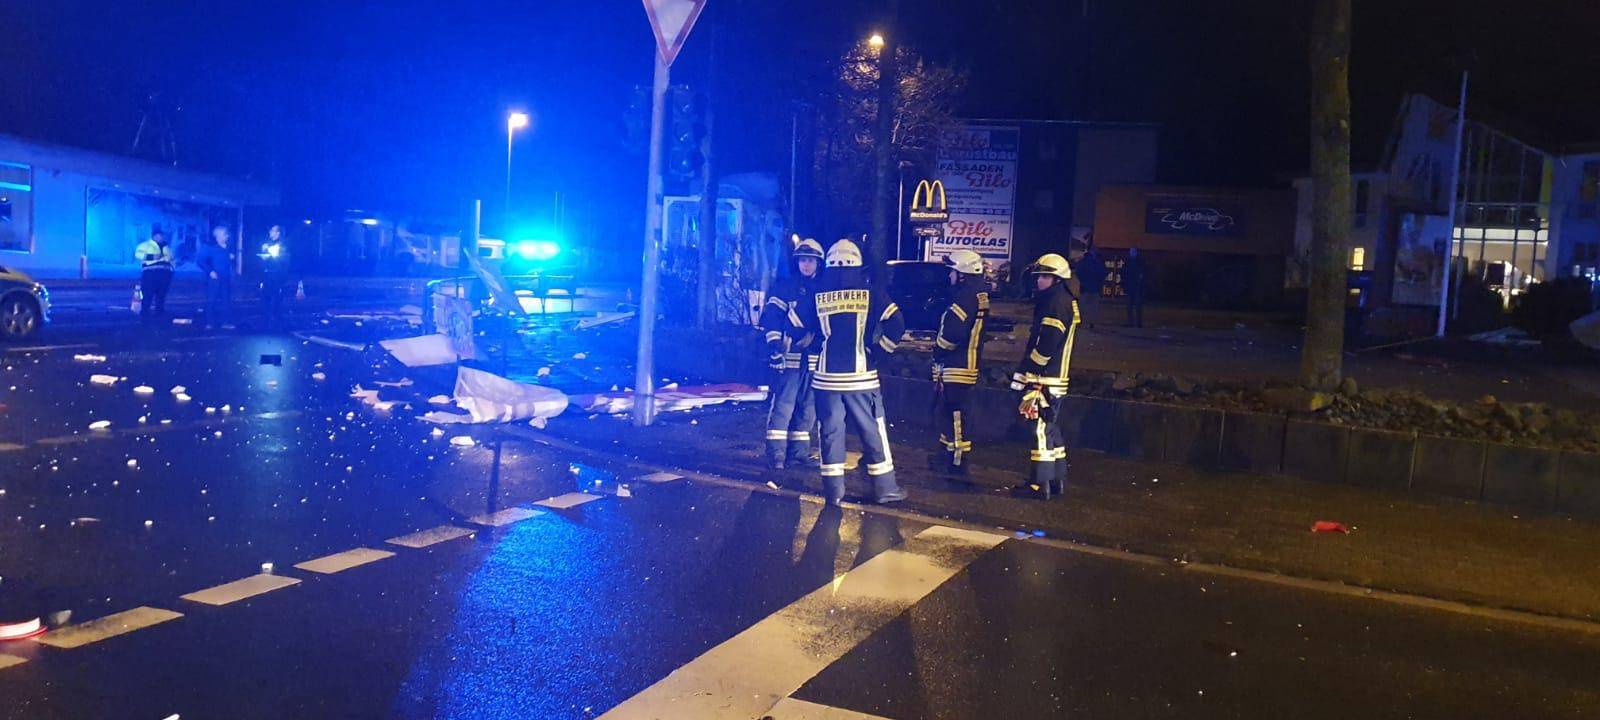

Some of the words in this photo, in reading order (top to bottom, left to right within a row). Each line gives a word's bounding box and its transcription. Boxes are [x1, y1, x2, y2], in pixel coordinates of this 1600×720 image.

[940, 163, 1004, 173] FASSADEN
[948, 220, 992, 235] Bilo
[935, 237, 1007, 246] AUTOGLAS
[816, 291, 868, 304] FEUERWEHR
